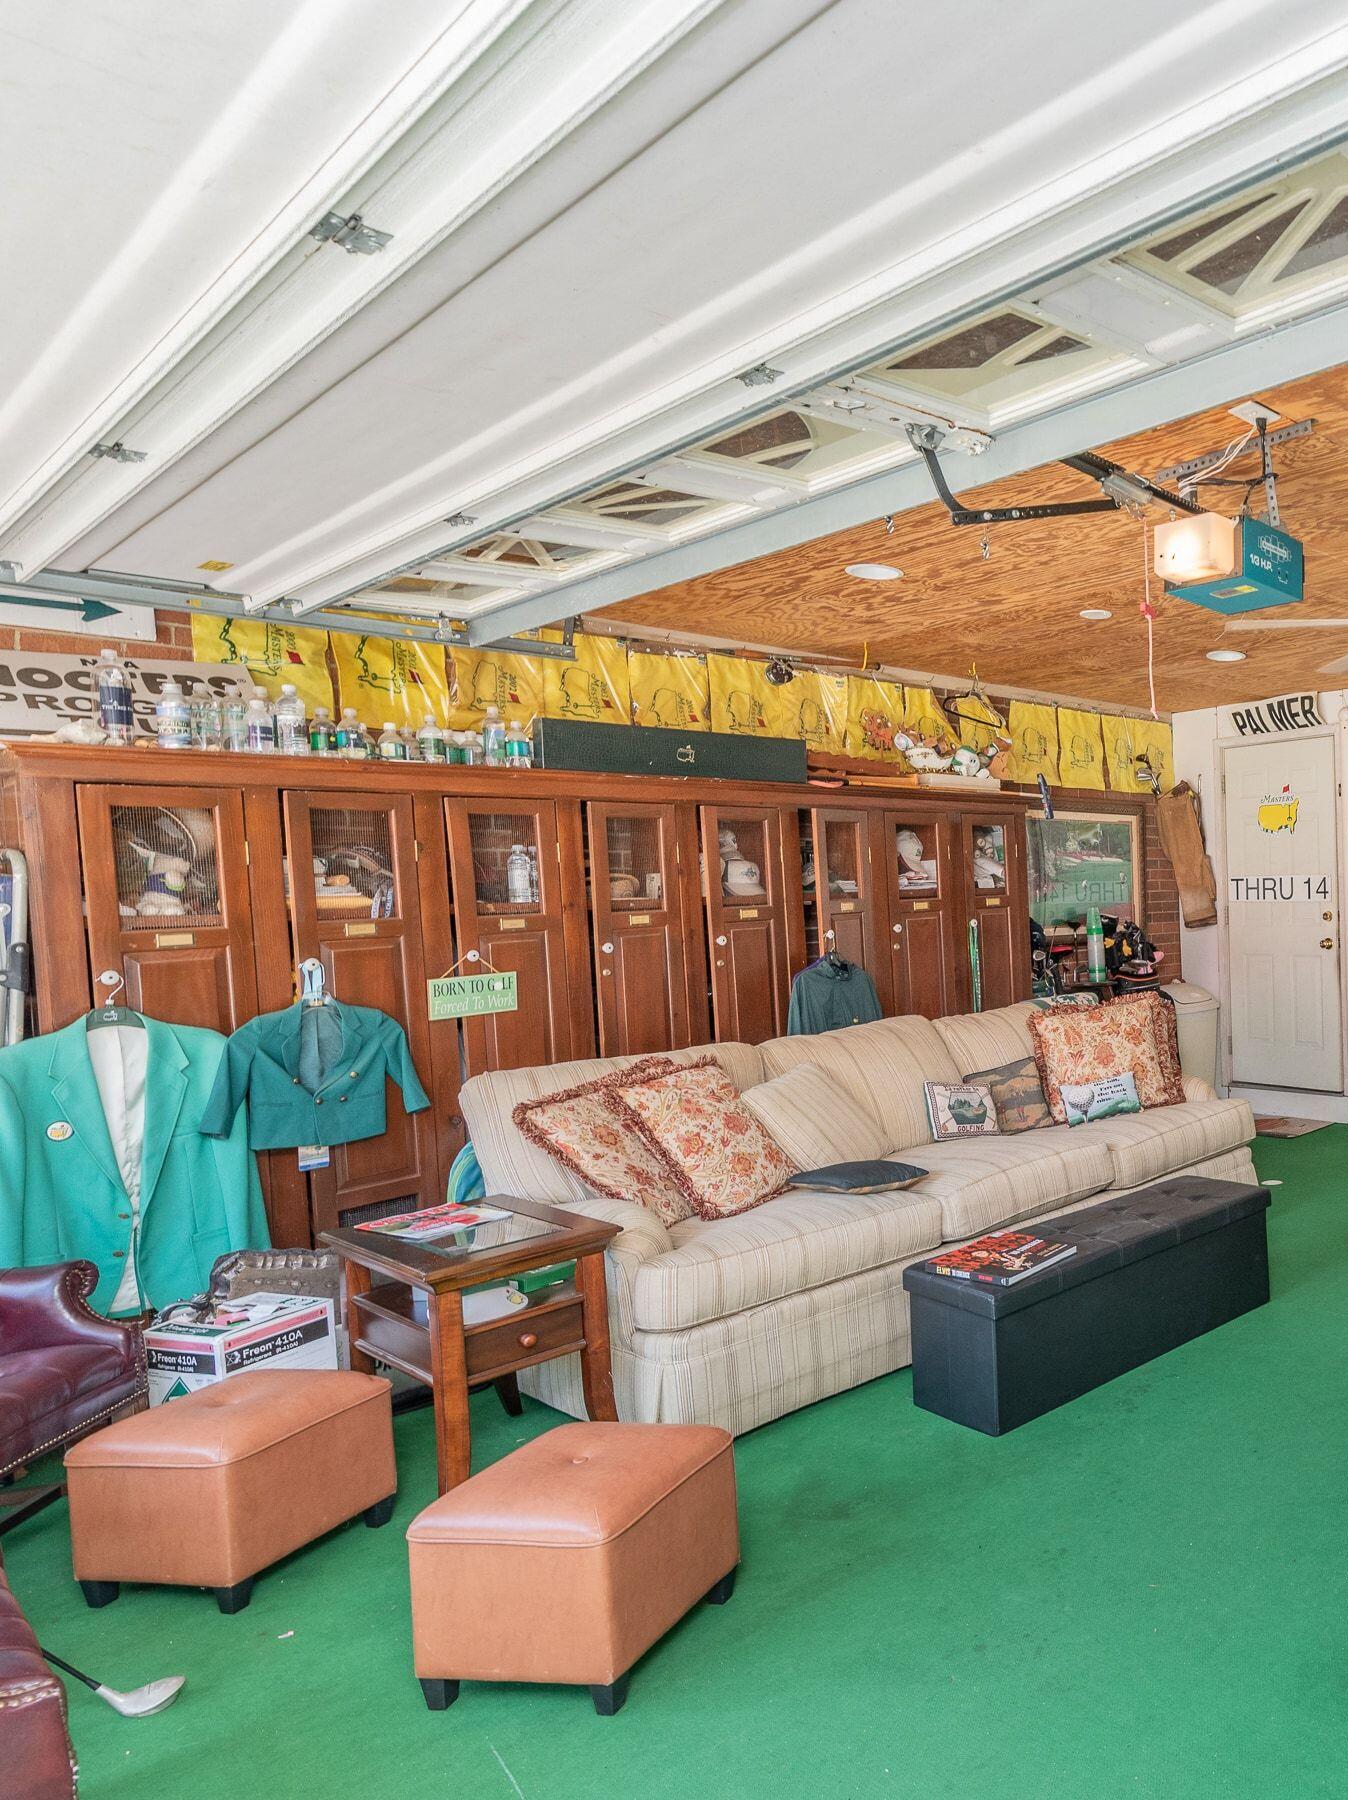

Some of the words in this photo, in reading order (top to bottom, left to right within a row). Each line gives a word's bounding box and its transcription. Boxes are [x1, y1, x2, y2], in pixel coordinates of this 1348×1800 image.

[1232, 695, 1322, 736] PALMER
[1231, 877, 1294, 900] THRU
[1303, 877, 1329, 900] 14
[433, 981, 466, 998] BORN
[467, 980, 483, 994] TO
[434, 997, 469, 1015] Forced
[473, 996, 484, 1010] To
[488, 993, 515, 1009] Work
[957, 1124, 985, 1132] GOLFING
[243, 1342, 272, 1359] Freon
[275, 1331, 303, 1347] 410A
[157, 1353, 176, 1365] Freon
[177, 1354, 197, 1367] 410A
